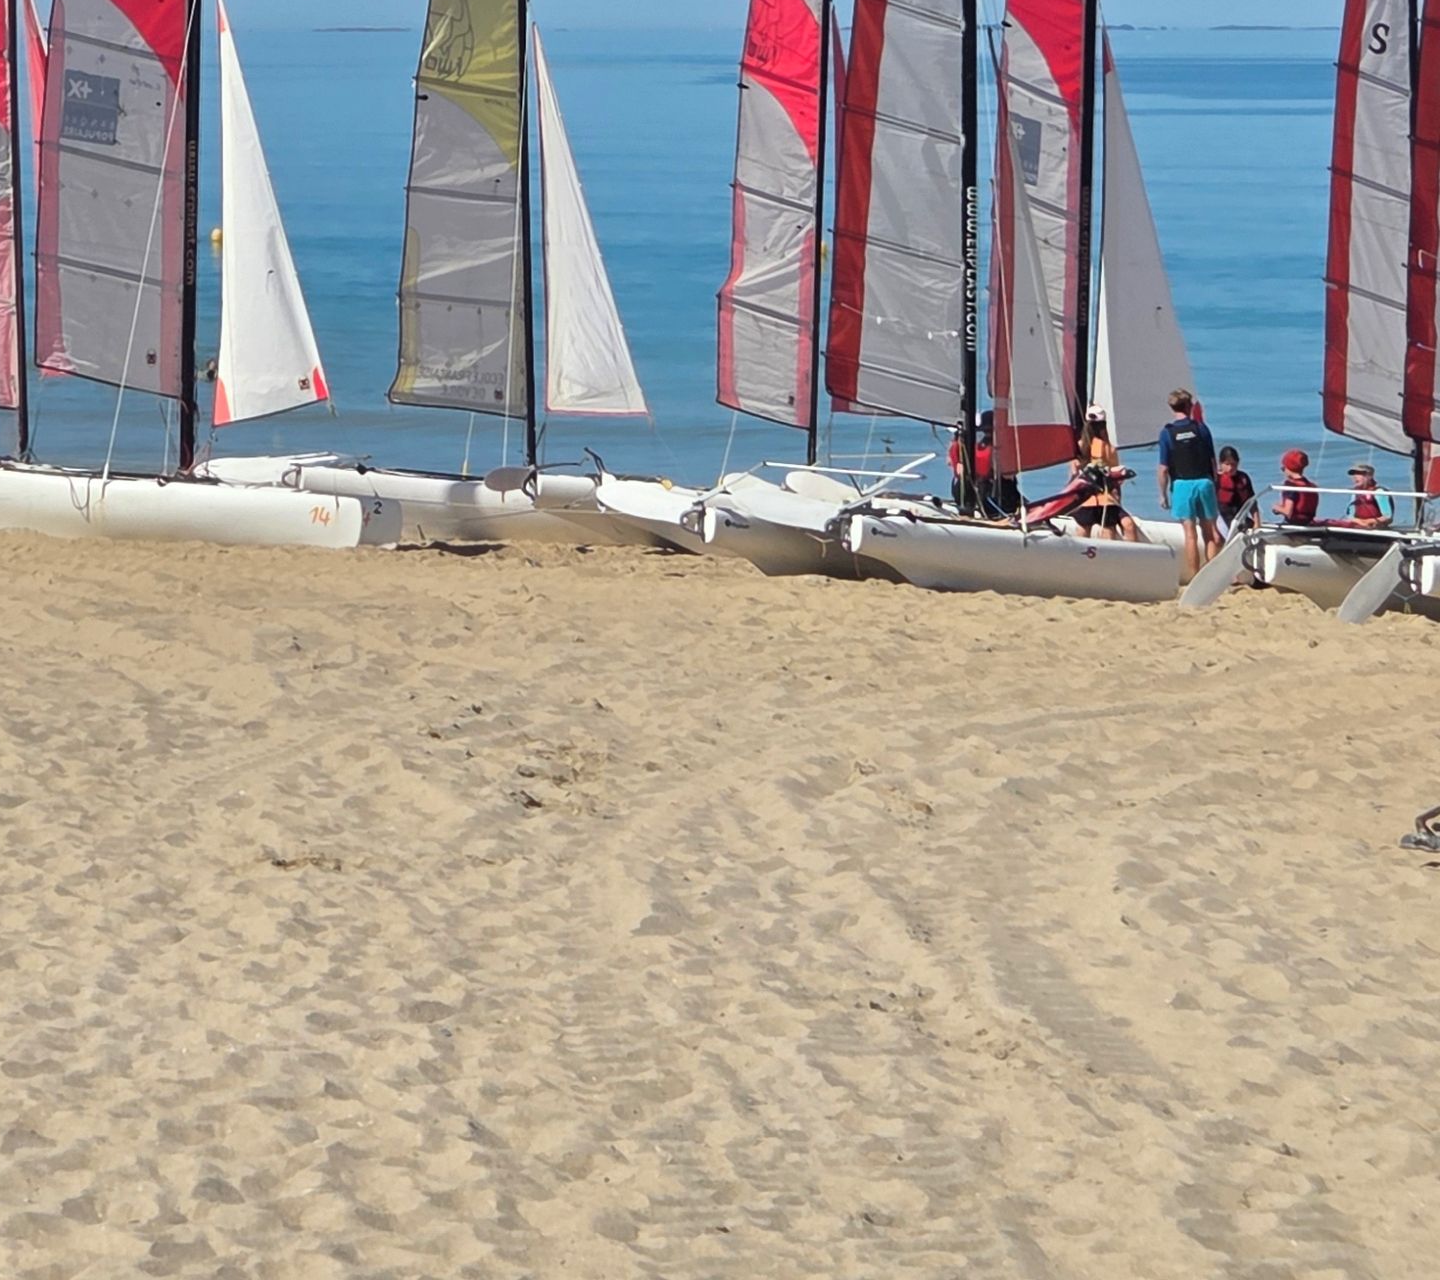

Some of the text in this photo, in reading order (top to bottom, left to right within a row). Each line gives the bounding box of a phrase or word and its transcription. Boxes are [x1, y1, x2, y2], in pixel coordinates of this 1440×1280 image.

[1368, 22, 1392, 55] S
[309, 505, 331, 527] 14
[372, 500, 383, 515] 2
